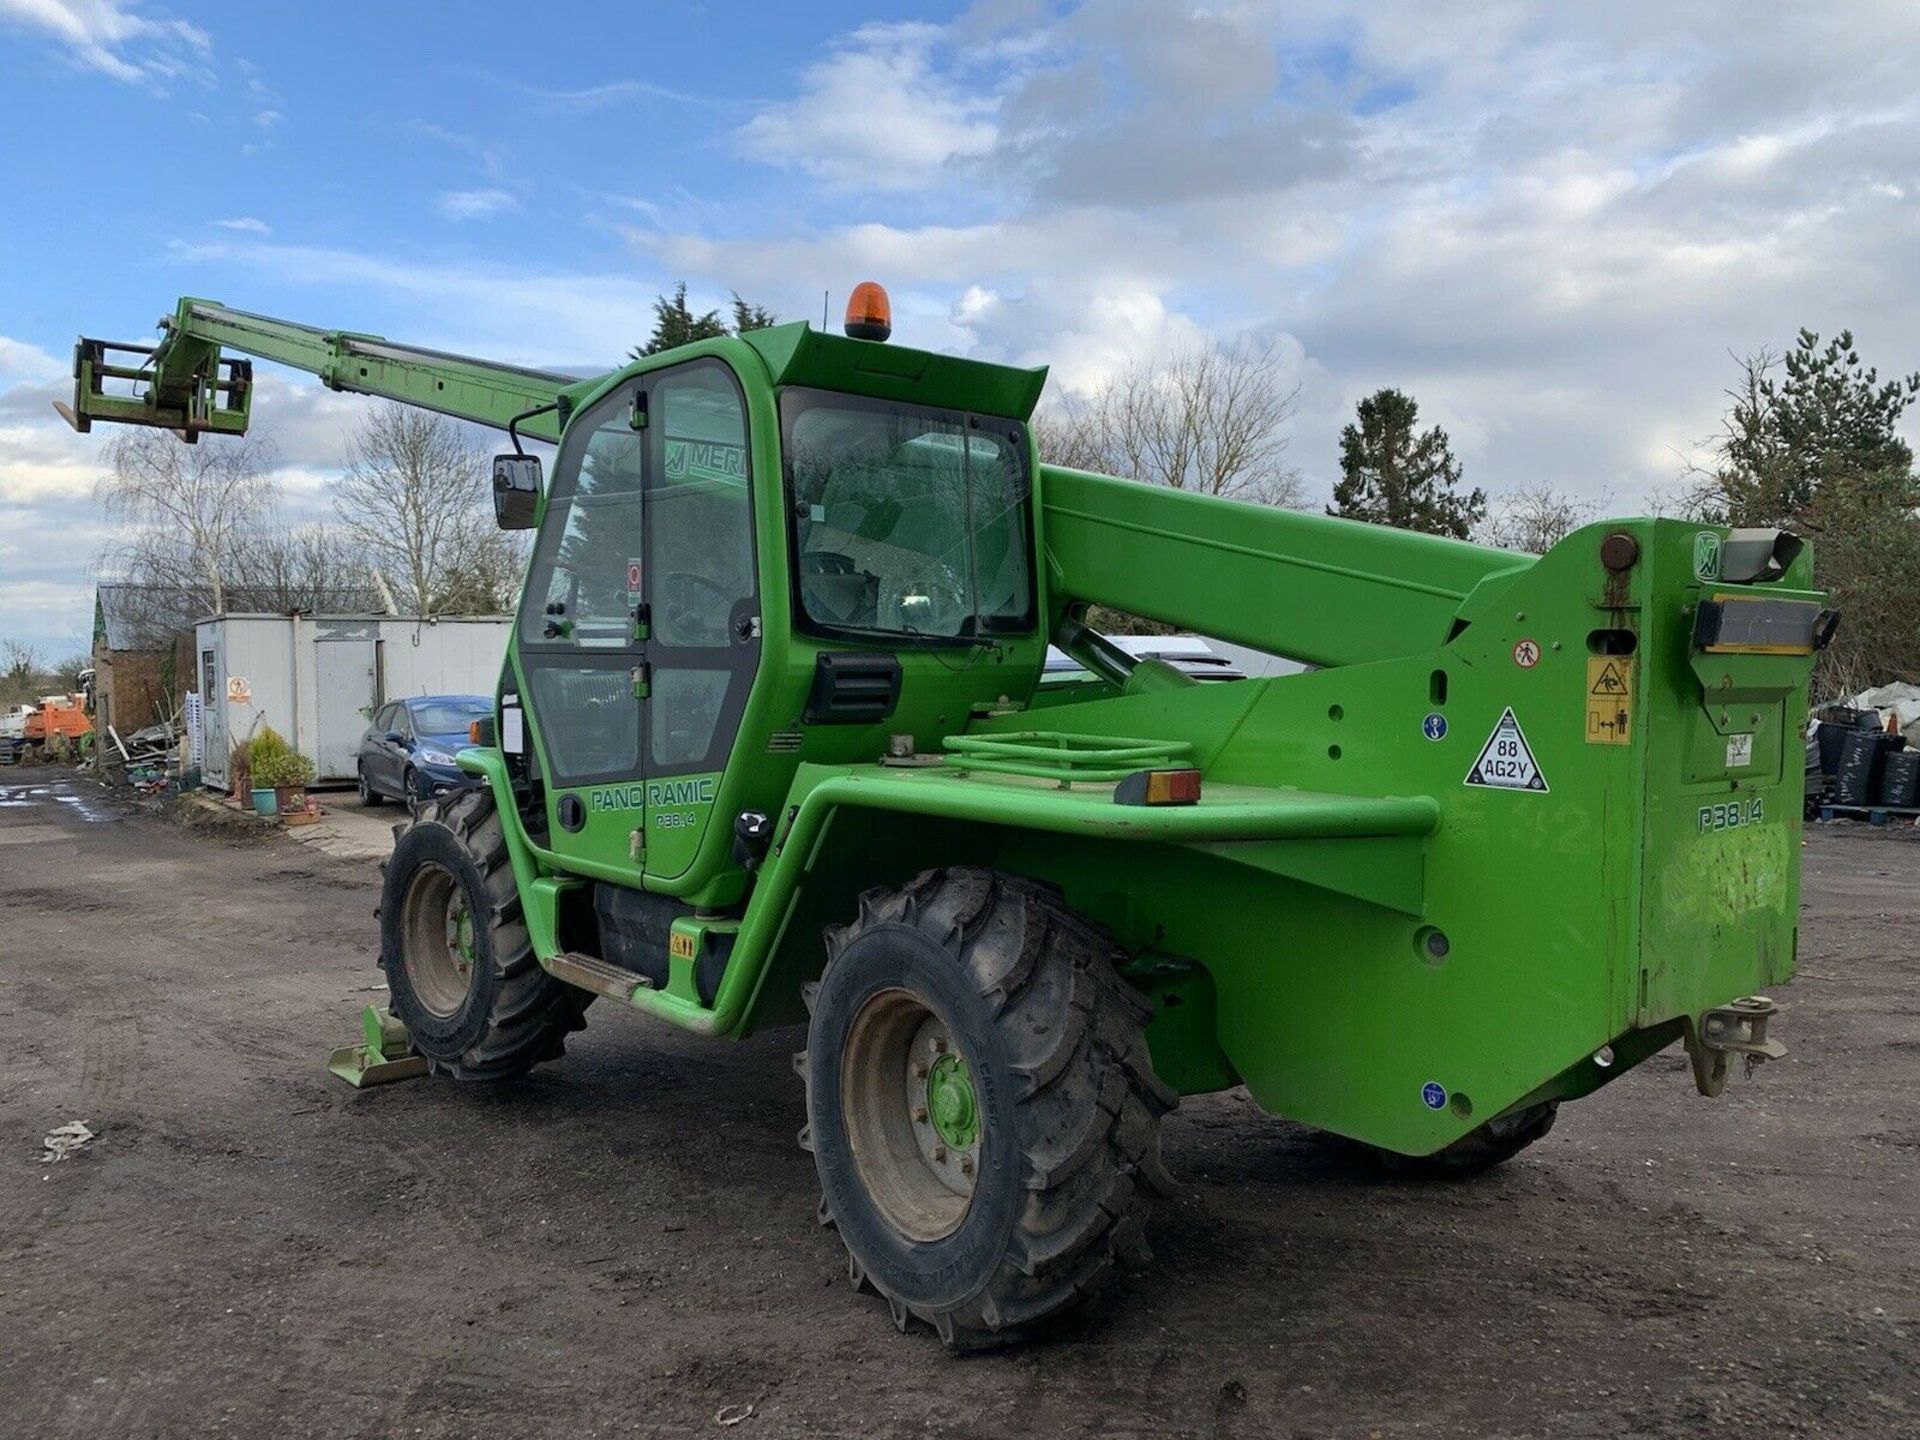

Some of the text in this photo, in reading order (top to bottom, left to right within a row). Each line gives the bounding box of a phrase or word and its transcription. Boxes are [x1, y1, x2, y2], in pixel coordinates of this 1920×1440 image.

[1497, 740, 1518, 757] 88
[1485, 760, 1528, 779] AG2Y
[591, 779, 714, 812] PANORAMIC
[1699, 798, 1764, 834] P38.14
